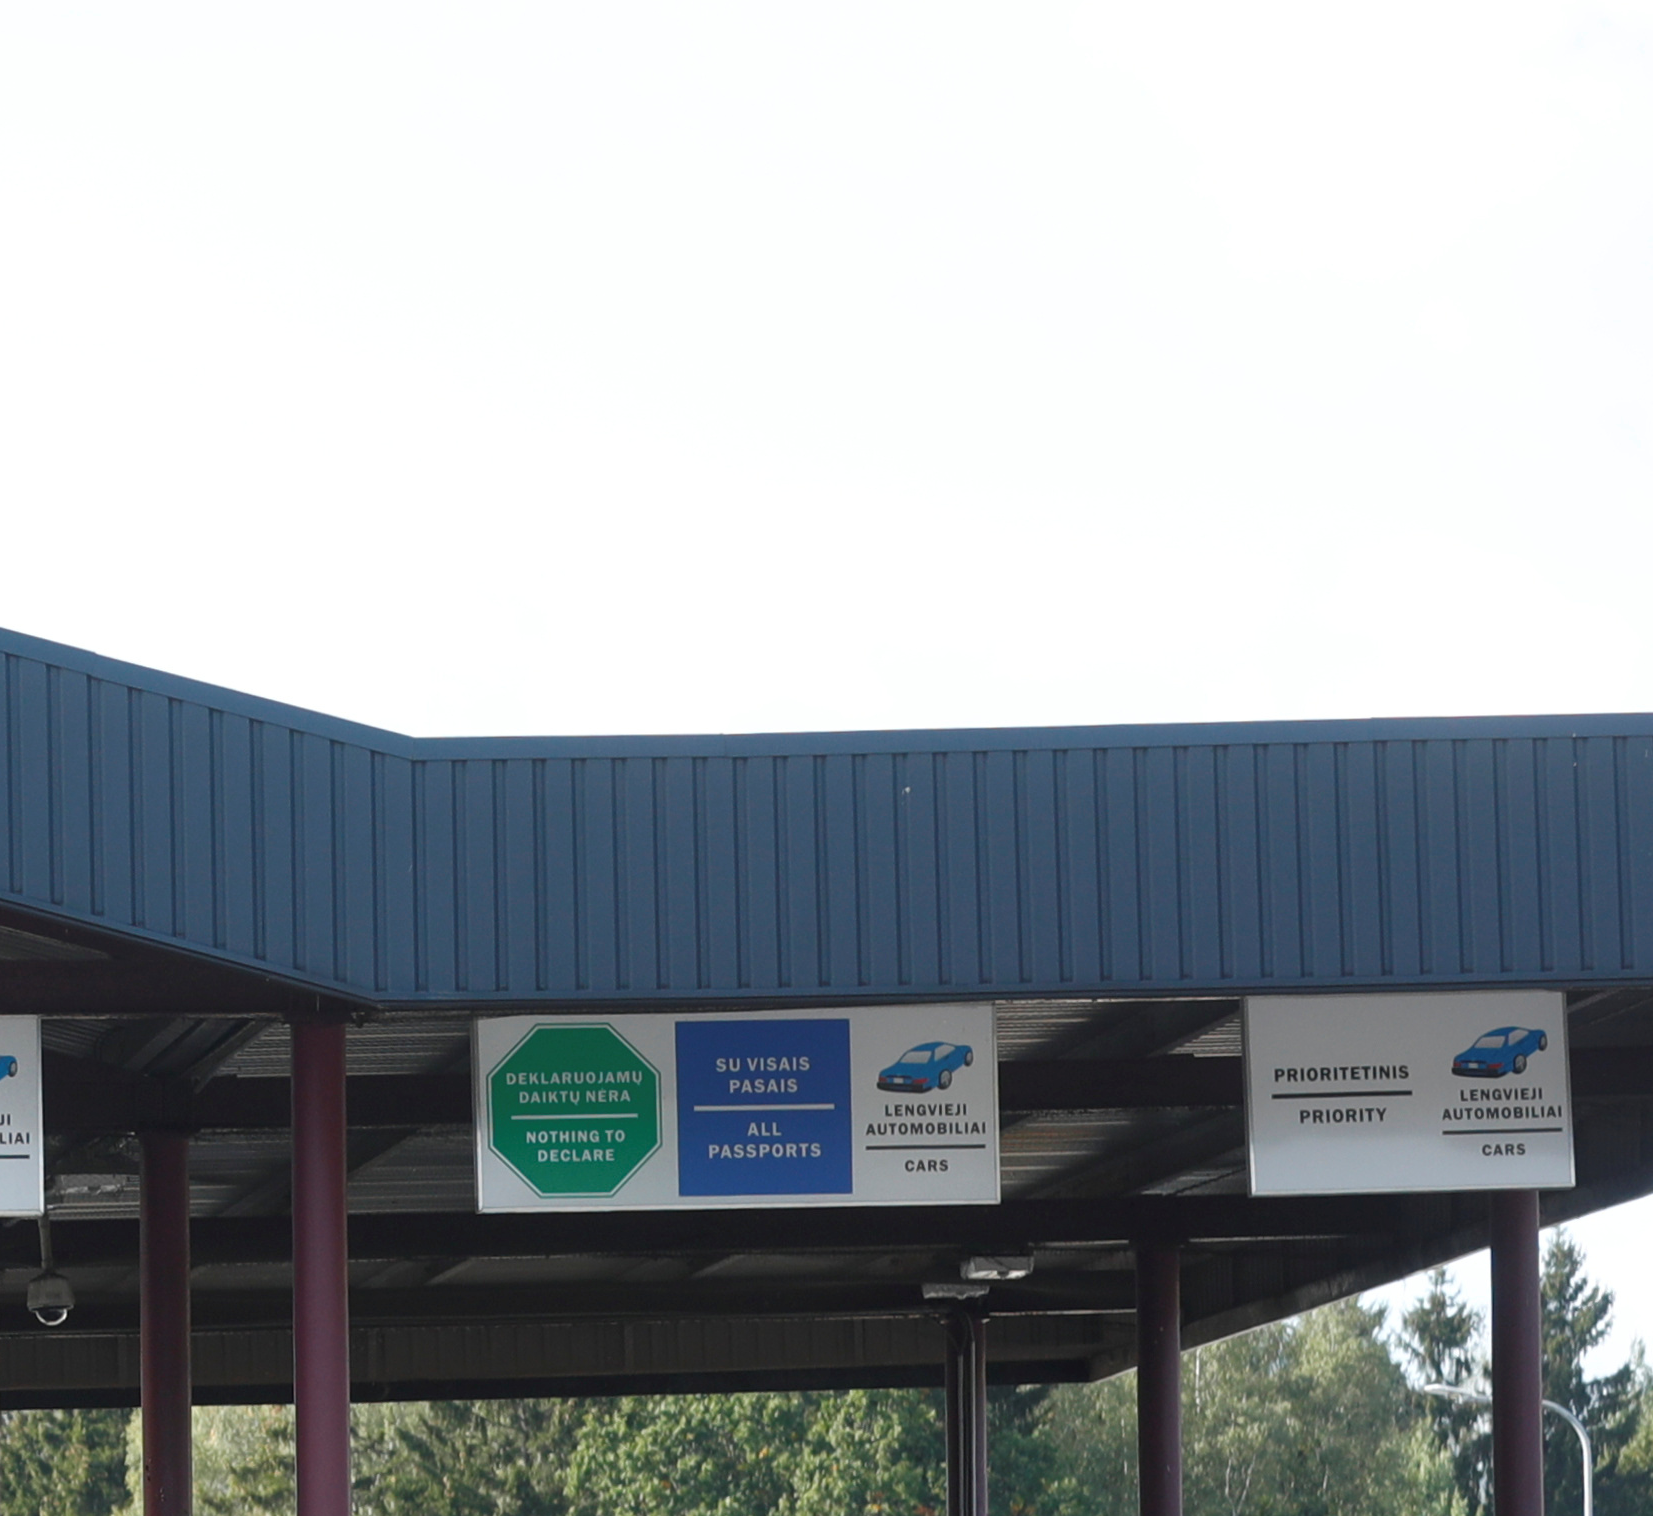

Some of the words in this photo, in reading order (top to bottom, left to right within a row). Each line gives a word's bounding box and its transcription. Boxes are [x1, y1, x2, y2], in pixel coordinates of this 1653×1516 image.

[717, 1058, 740, 1072] SU
[747, 1057, 809, 1071] VISAIS
[507, 1071, 642, 1085] DEKLARUOJAMŲ
[1275, 1065, 1408, 1082] PRIORITETINIS
[730, 1079, 797, 1093] PASAIS
[520, 1091, 579, 1104] DAIKTŲ
[586, 1085, 630, 1102] NĖRA
[1461, 1088, 1542, 1101] LENGVIEJI
[885, 1104, 966, 1116] LENGVIEJI
[1300, 1108, 1386, 1123] PRIORITY
[1443, 1106, 1562, 1120] AUTOMOBILIAI
[748, 1123, 781, 1136] ALL
[866, 1122, 985, 1135] AUTOMOBILIAI
[527, 1131, 599, 1143] NOTHING
[605, 1130, 625, 1142] TO
[538, 1149, 614, 1162] DECLARE
[709, 1143, 820, 1158] PASSPORTS
[1482, 1143, 1525, 1156] CARS
[905, 1160, 948, 1172] CARS
